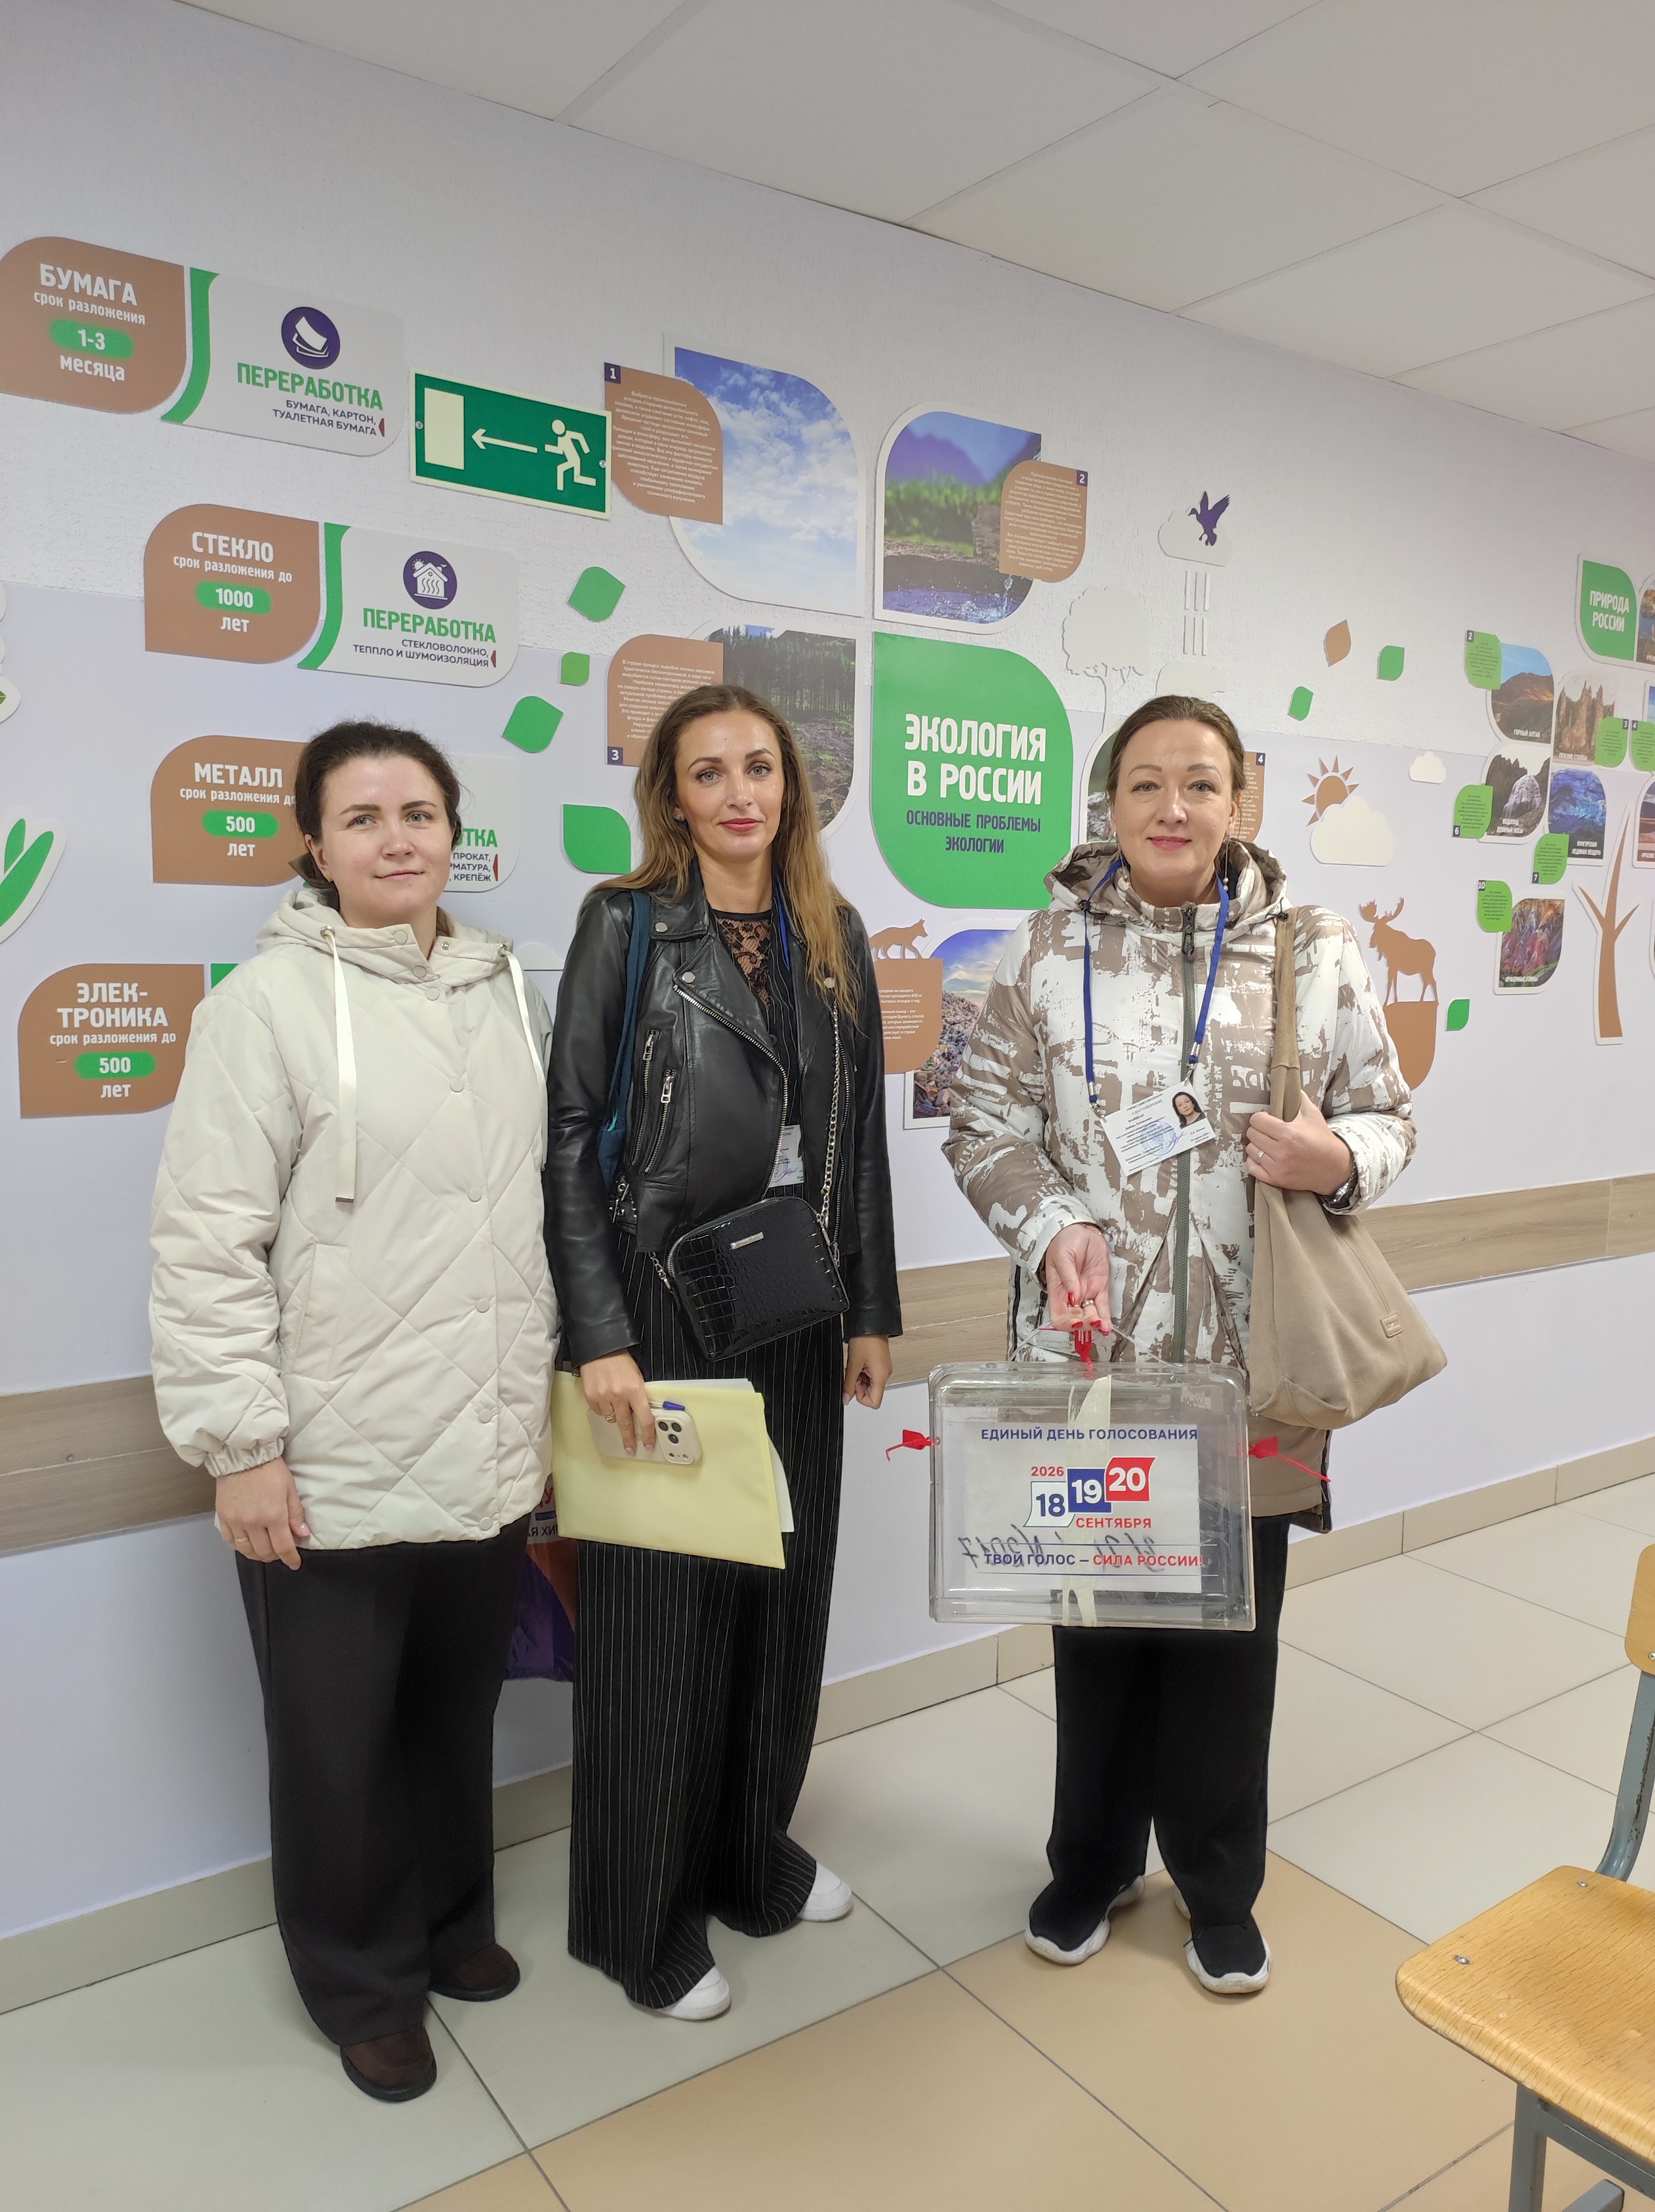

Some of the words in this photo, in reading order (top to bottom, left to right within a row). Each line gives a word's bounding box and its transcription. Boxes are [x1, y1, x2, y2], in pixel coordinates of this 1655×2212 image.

[40, 263, 138, 306] БУМАГА
[34, 292, 63, 307] срок
[69, 299, 145, 325] разложения
[78, 329, 105, 350] 1-3
[60, 355, 125, 382] месяца
[609, 368, 617, 380] 1
[237, 362, 383, 410] ПЕРЕРАБОТКА
[286, 399, 330, 417] БУМАГА,
[333, 409, 377, 425] КАРТОН,
[272, 409, 334, 428] ТУАЛЕТНАЯ
[336, 421, 377, 436] БУМАГА
[1079, 473, 1085, 484] 2
[192, 532, 274, 563] СТЕКЛО
[174, 556, 200, 568] срок
[204, 560, 274, 580] разложения
[278, 572, 292, 583] до
[215, 588, 254, 608] 1000
[1589, 590, 1630, 615] ПРИРОДА
[220, 616, 249, 633] лет
[363, 608, 496, 643] ПЕРЕРАБОТКА
[1592, 611, 1625, 633] РОССИИ
[1468, 632, 1473, 641] 2
[353, 645, 394, 656] ТЕППЛО
[396, 649, 403, 657] И
[406, 651, 489, 667] ШУМОИЗОЛЯЦИЯ
[401, 639, 489, 658] СТЕКЛОВОЛОКНО,
[905, 713, 1046, 762] ЭКОЛОГИЯ
[1513, 728, 1528, 737] ГОРНЫЙ
[1529, 730, 1540, 738] АЛТАЙ
[611, 749, 619, 761] 3
[1258, 754, 1263, 764] 4
[194, 762, 283, 788] МЕТАЛЛ
[907, 760, 927, 796] В
[940, 763, 1042, 805] РОССИИ
[180, 788, 206, 800] срок
[211, 790, 279, 804] разложения
[225, 816, 255, 833] 500
[906, 809, 971, 829] ОСНОВНЫЕ
[976, 814, 1041, 832] ПРОБЛЕМЫ
[227, 843, 255, 857] лет
[945, 836, 1005, 854] ЭКОЛОГИИ
[450, 862, 490, 872] МАТУРА,
[453, 852, 490, 862] ПРОКАТ,
[454, 872, 491, 881] КРЕПЁЖ
[77, 983, 148, 1003] ЭЛЕК-
[57, 1007, 168, 1028] ТРОНИКА
[50, 1034, 78, 1046] срок
[83, 1033, 157, 1046] разложения
[162, 1033, 176, 1044] до
[99, 1057, 131, 1074] 500
[100, 1084, 131, 1098] лет
[981, 1427, 1043, 1441] ЕДИНЫЙ
[1047, 1429, 1084, 1441] ДЕНЬ
[1089, 1429, 1198, 1440] ГОЛОСОВАНИЯ
[1031, 1466, 1064, 1476] 2026
[1109, 1467, 1146, 1492] 20
[1071, 1479, 1103, 1504] 19
[1036, 1494, 1065, 1517] 18
[1076, 1517, 1152, 1528] СЕНТЯБРЯ
[984, 1550, 1023, 1565] ТВОЙ
[1028, 1554, 1075, 1565] ГОЛОС
[1093, 1555, 1131, 1566] СИЛА
[1138, 1555, 1204, 1567] РОССИИ!
